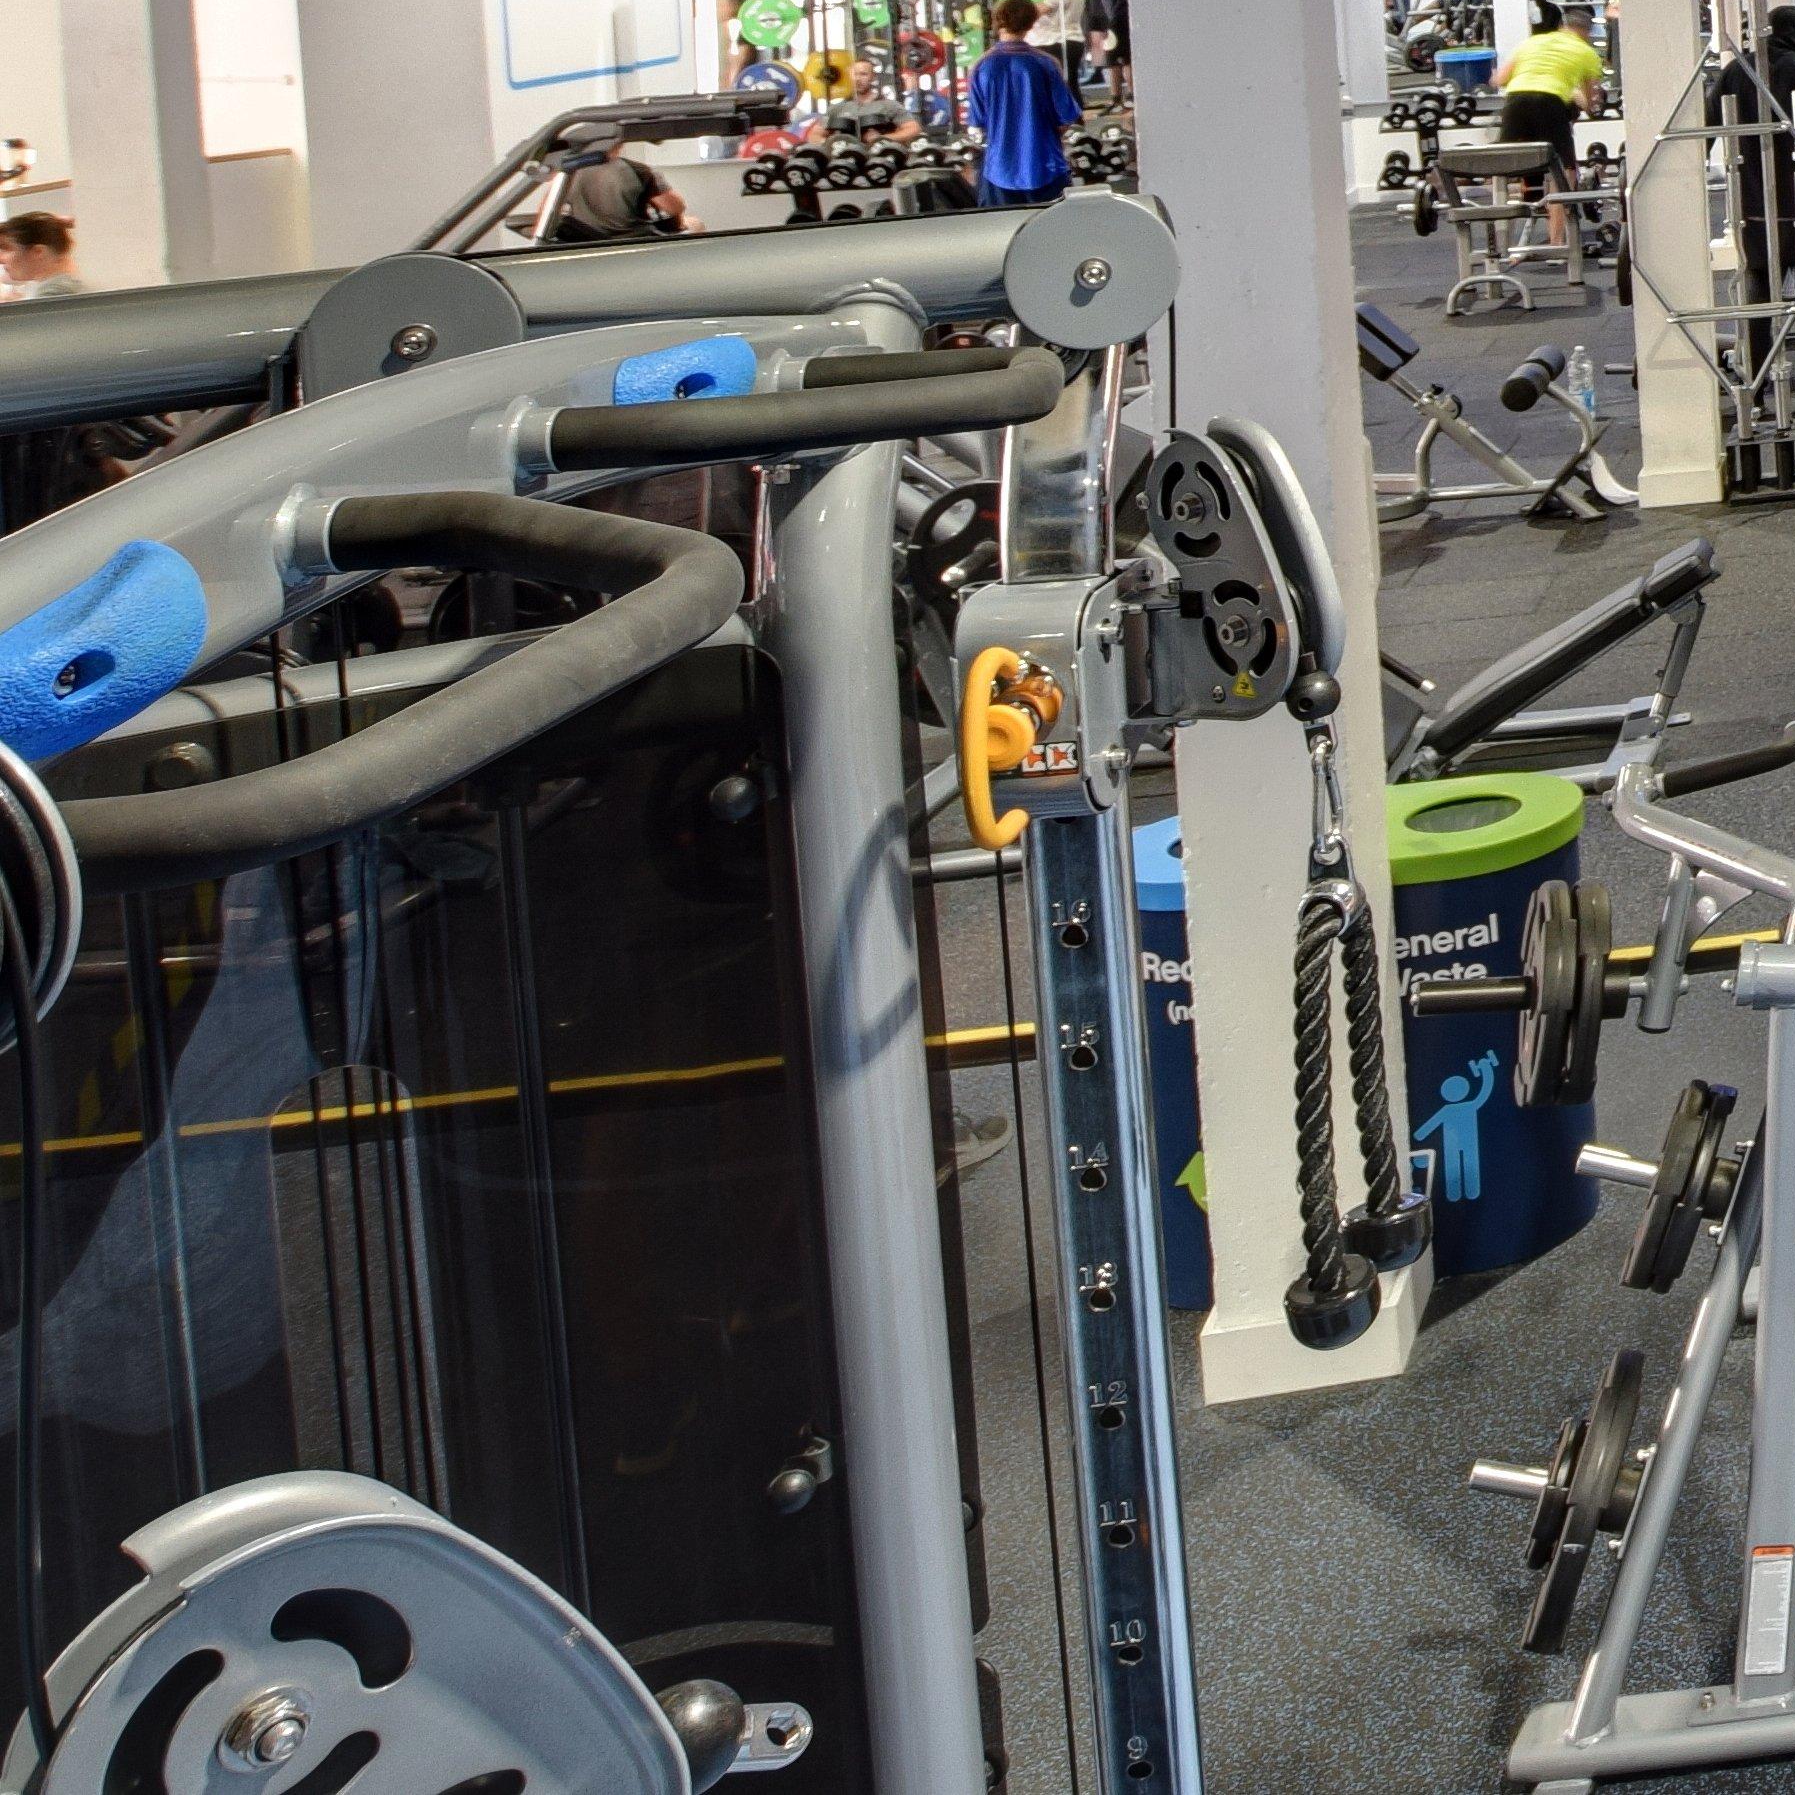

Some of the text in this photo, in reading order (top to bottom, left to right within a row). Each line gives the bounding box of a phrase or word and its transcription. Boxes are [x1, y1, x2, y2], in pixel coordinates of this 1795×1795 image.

[1052, 899, 1091, 927] 16
[1396, 913, 1500, 960] eneral
[1068, 1141, 1109, 1171] 14
[1089, 1379, 1128, 1408] 12
[1099, 1500, 1138, 1527] 11
[1109, 1619, 1147, 1646] 10
[1126, 1734, 1149, 1761] 9
